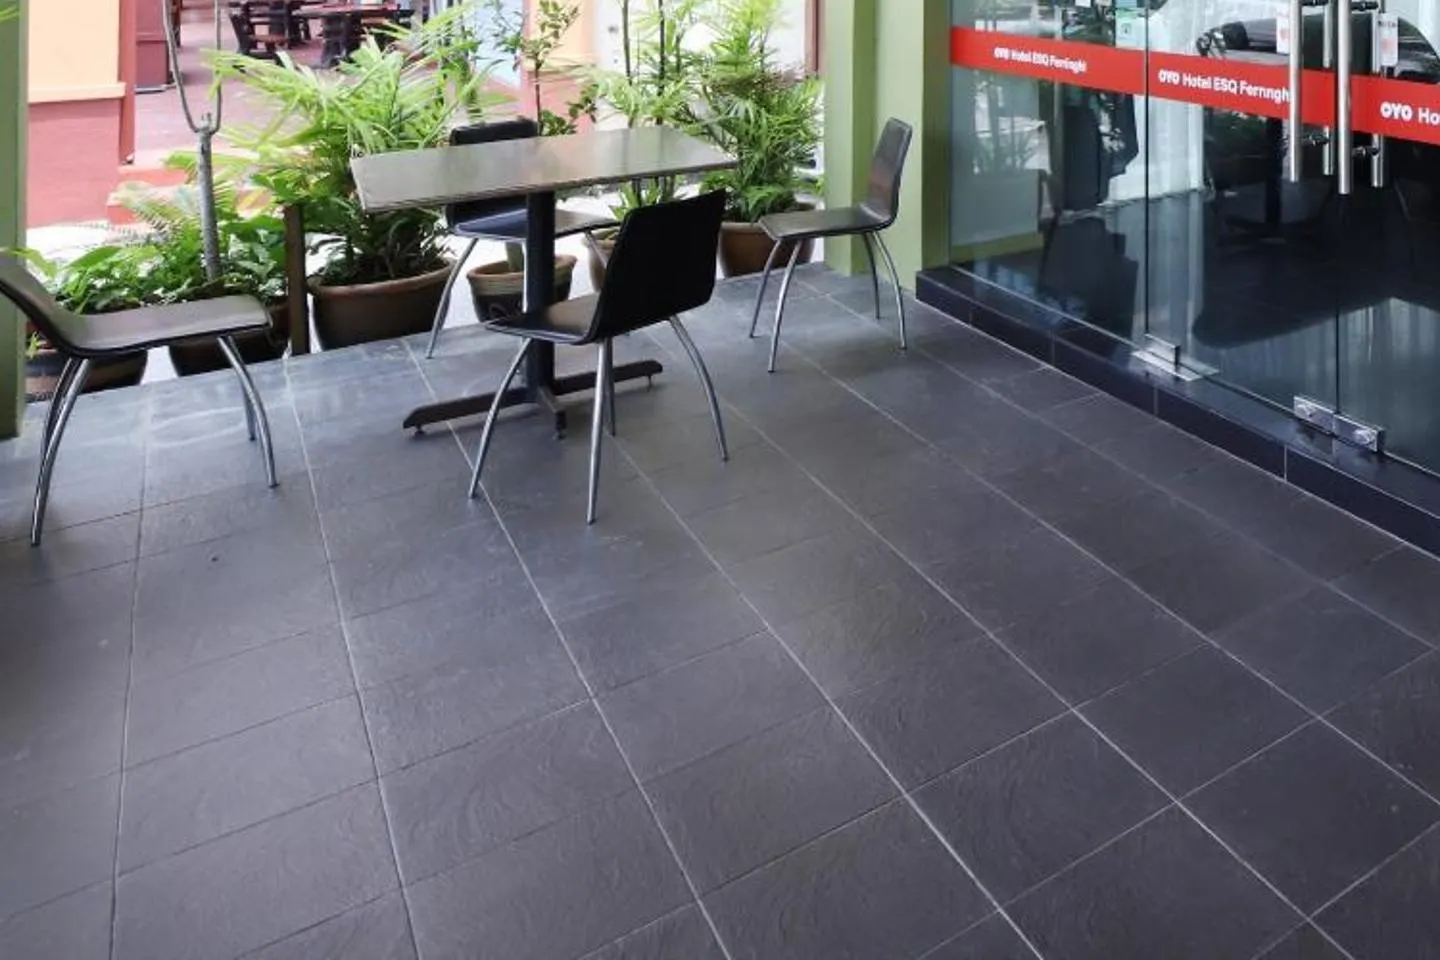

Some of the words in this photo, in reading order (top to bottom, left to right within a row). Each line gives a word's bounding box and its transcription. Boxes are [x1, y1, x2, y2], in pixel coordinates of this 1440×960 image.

[1158, 69, 1180, 85] OYO
[1182, 73, 1212, 89] Hotel
[1214, 76, 1238, 94] ESQ
[1240, 80, 1291, 104] Ferringh
[1380, 101, 1414, 121] OYO
